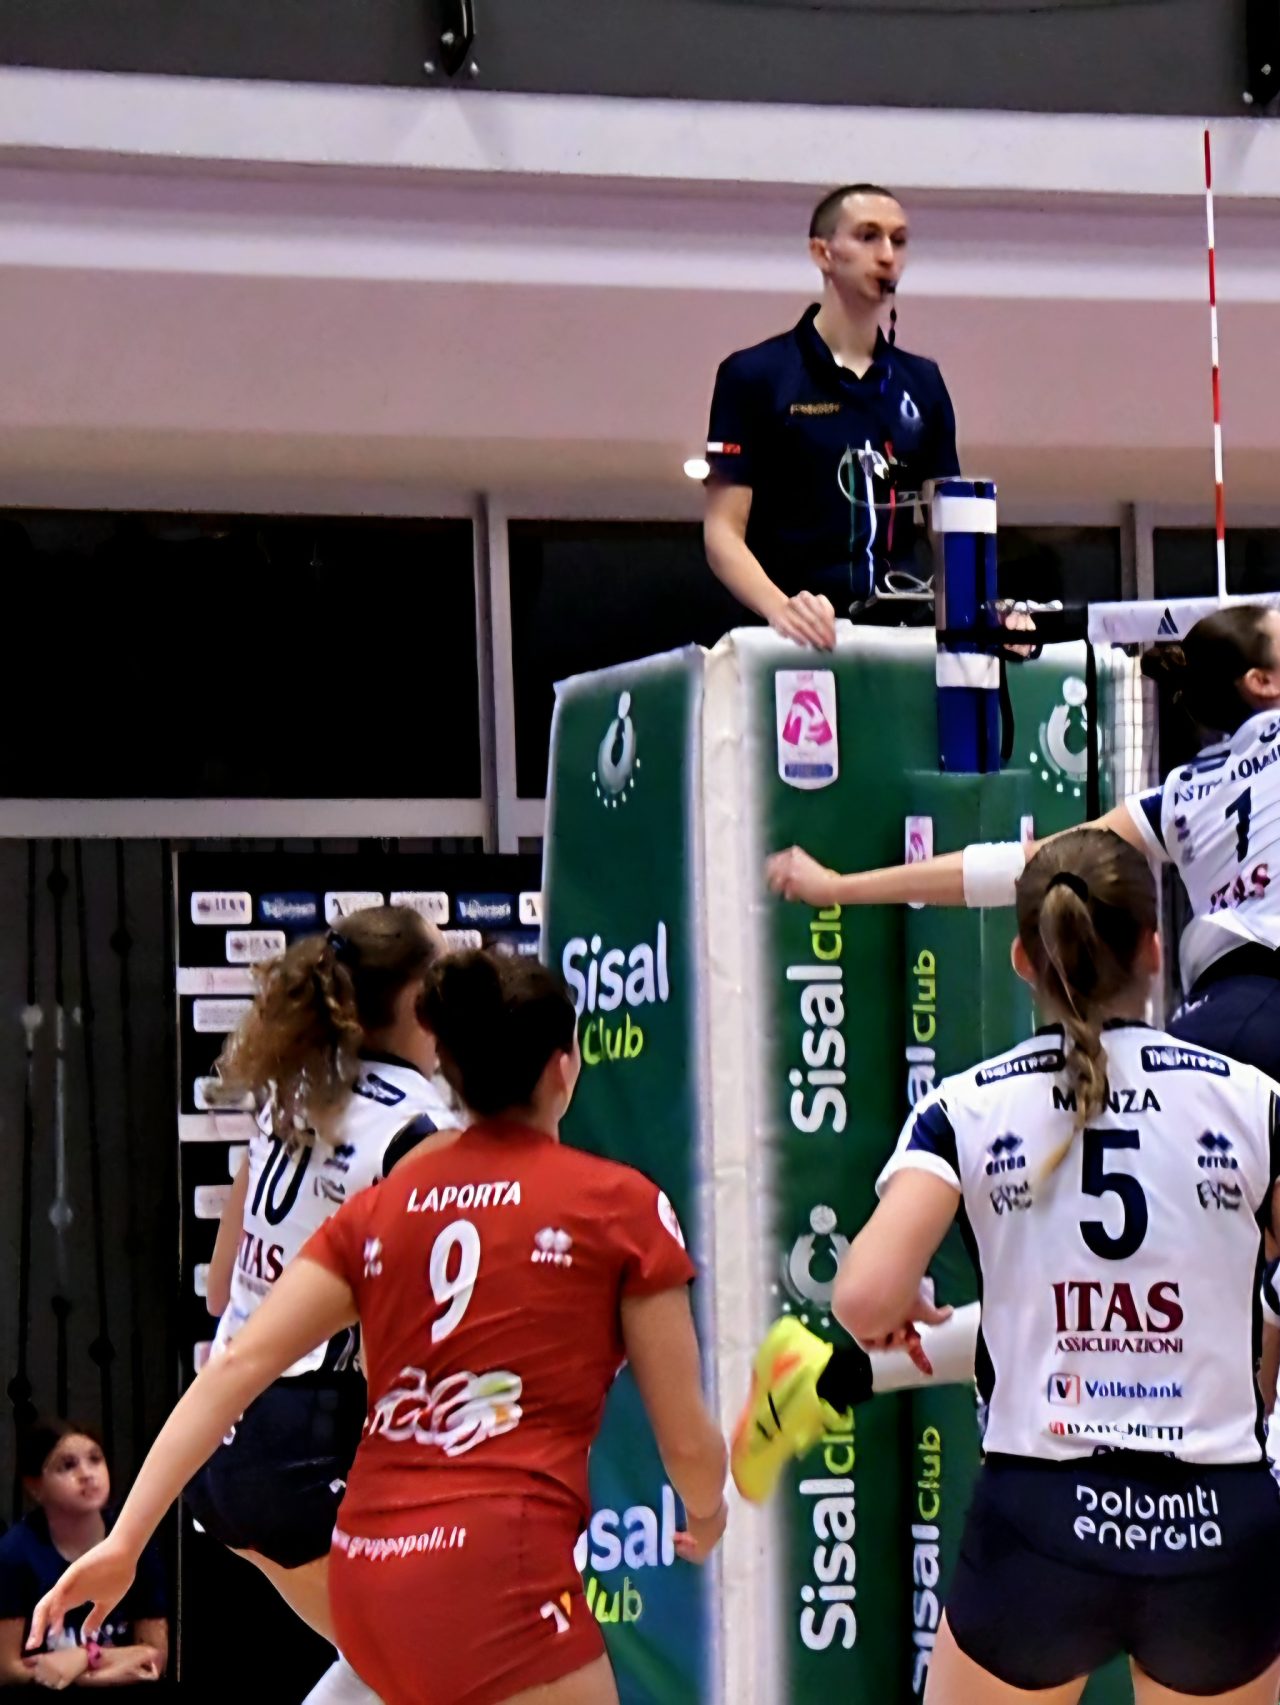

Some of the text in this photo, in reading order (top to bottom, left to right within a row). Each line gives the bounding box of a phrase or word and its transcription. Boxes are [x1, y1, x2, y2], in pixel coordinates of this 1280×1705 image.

[1225, 786, 1252, 863] 1
[562, 920, 669, 1018] Sisal
[913, 949, 936, 1042] Club
[582, 1012, 644, 1066] Club
[786, 901, 847, 1133] Sisal Clu
[1052, 1085, 1161, 1114] MNZA
[406, 1181, 521, 1213] LAPORTA
[1081, 1128, 1148, 1260] 5
[429, 1219, 481, 1344] 9
[1052, 1282, 1184, 1333] ITAS
[1085, 1380, 1183, 1399] Volksbank
[799, 1478, 857, 1651] Sisal
